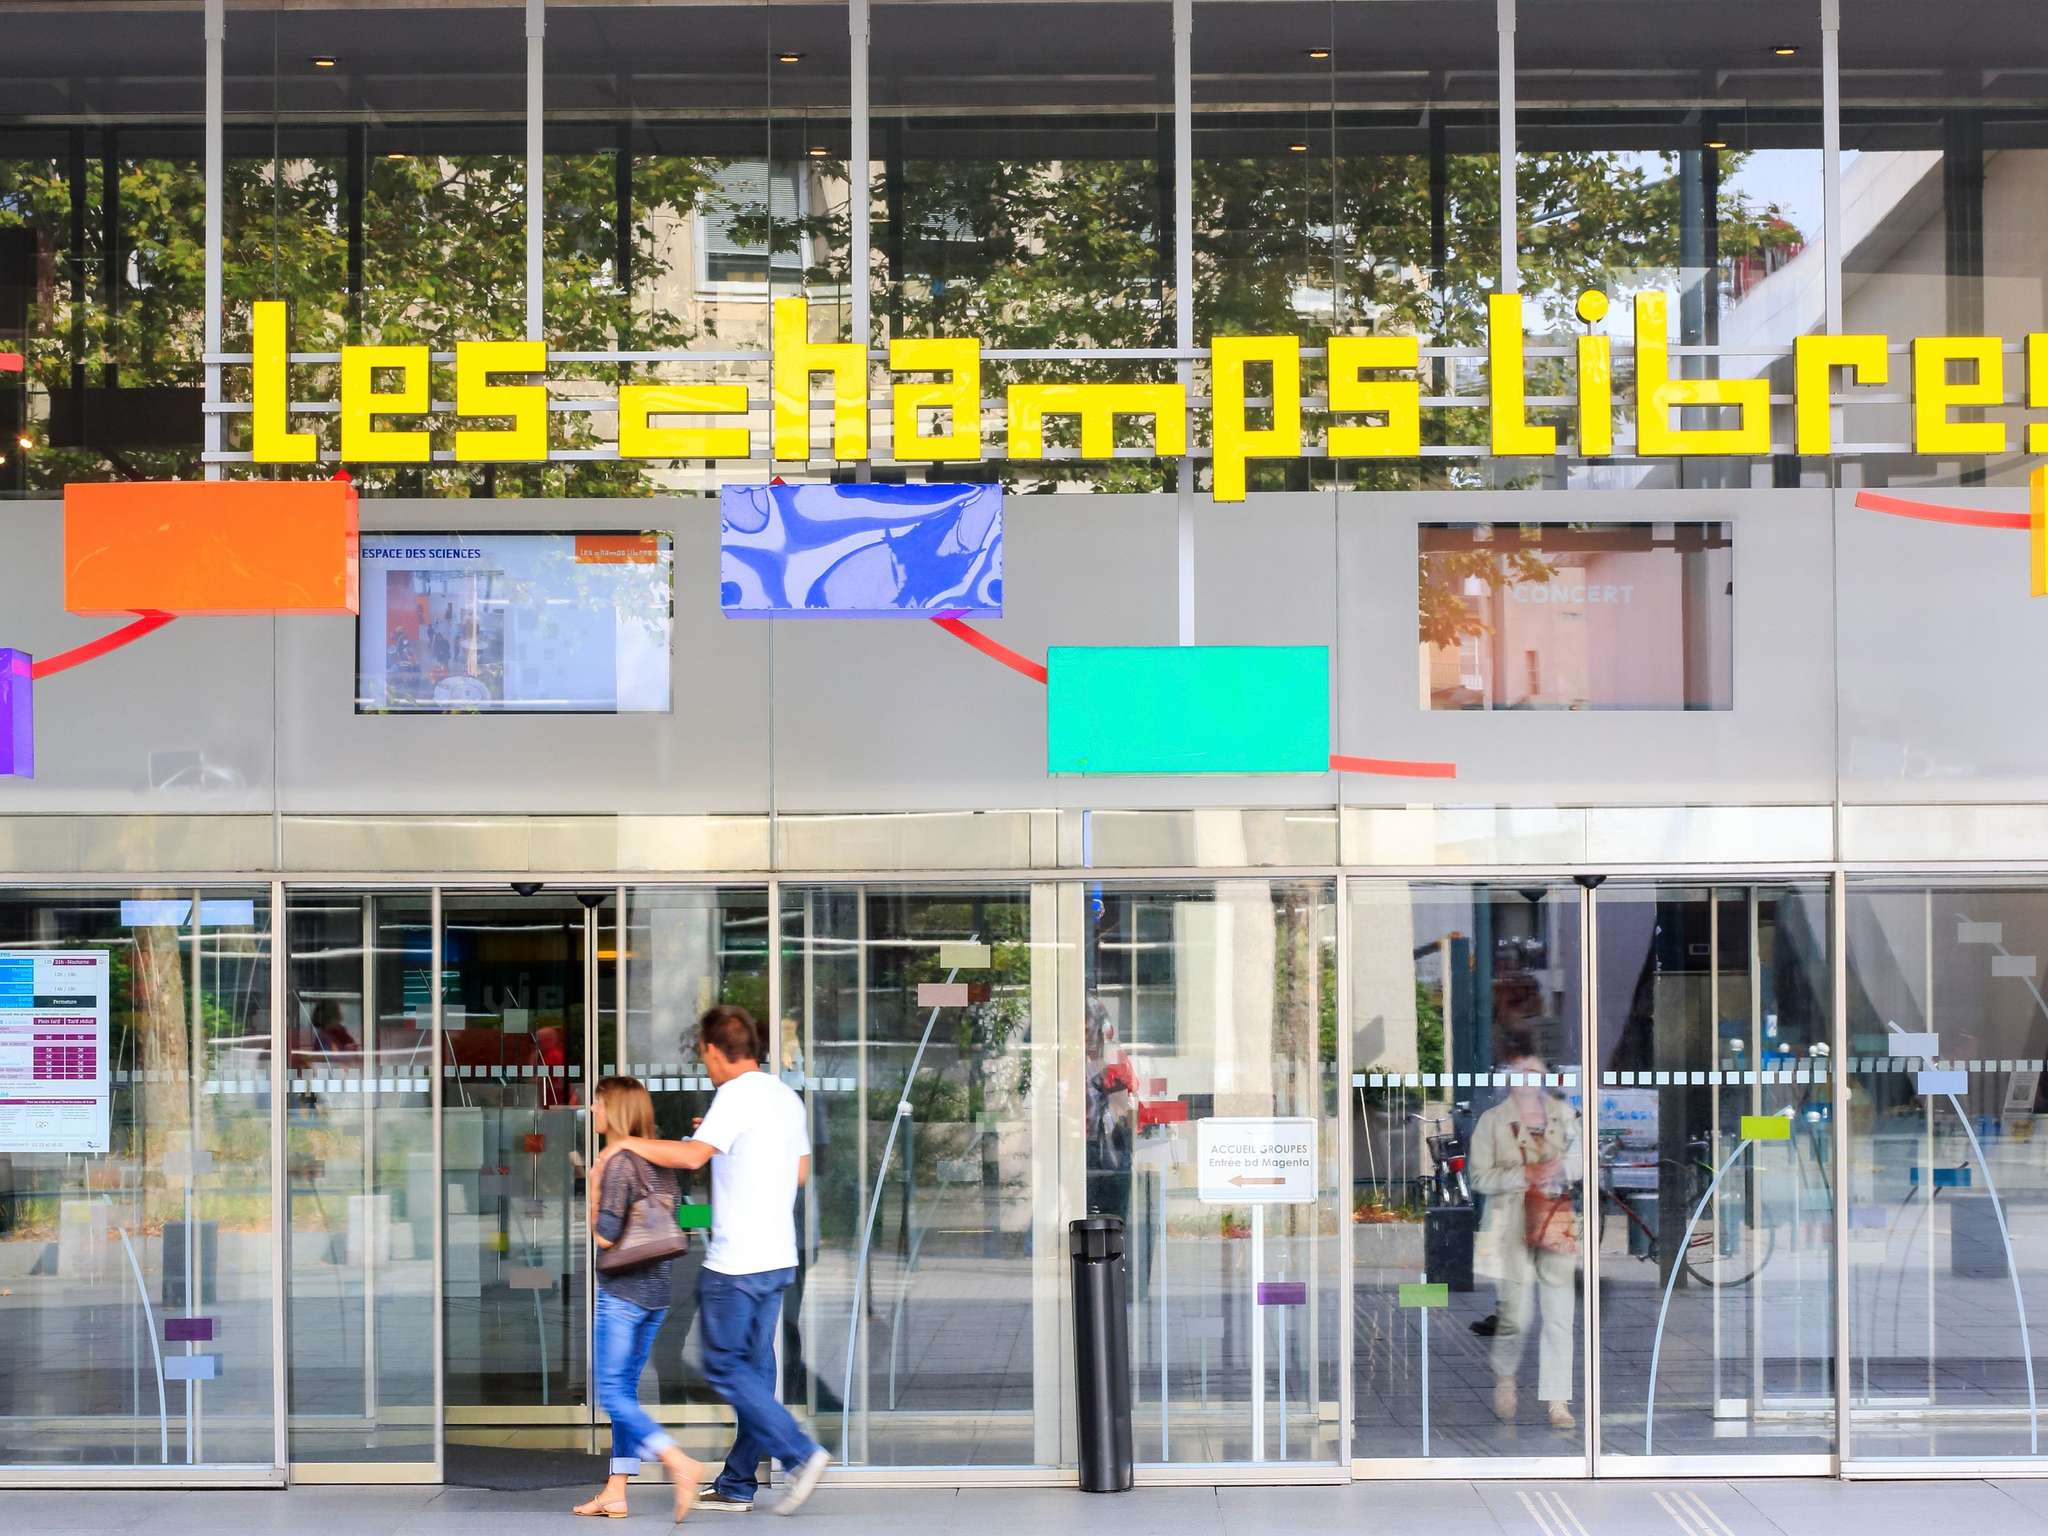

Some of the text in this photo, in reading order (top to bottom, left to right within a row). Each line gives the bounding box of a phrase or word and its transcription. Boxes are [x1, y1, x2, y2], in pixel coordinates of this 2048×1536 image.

[619, 296, 1422, 501] champs
[1490, 290, 2048, 456] libre
[361, 548, 481, 559] ESPACE DES SCIENCES
[1512, 584, 1635, 605] CONCERT
[1210, 1144, 1308, 1154] ACCUEIL GROUPES
[1209, 1158, 1310, 1169] Entrée bd Magenta
